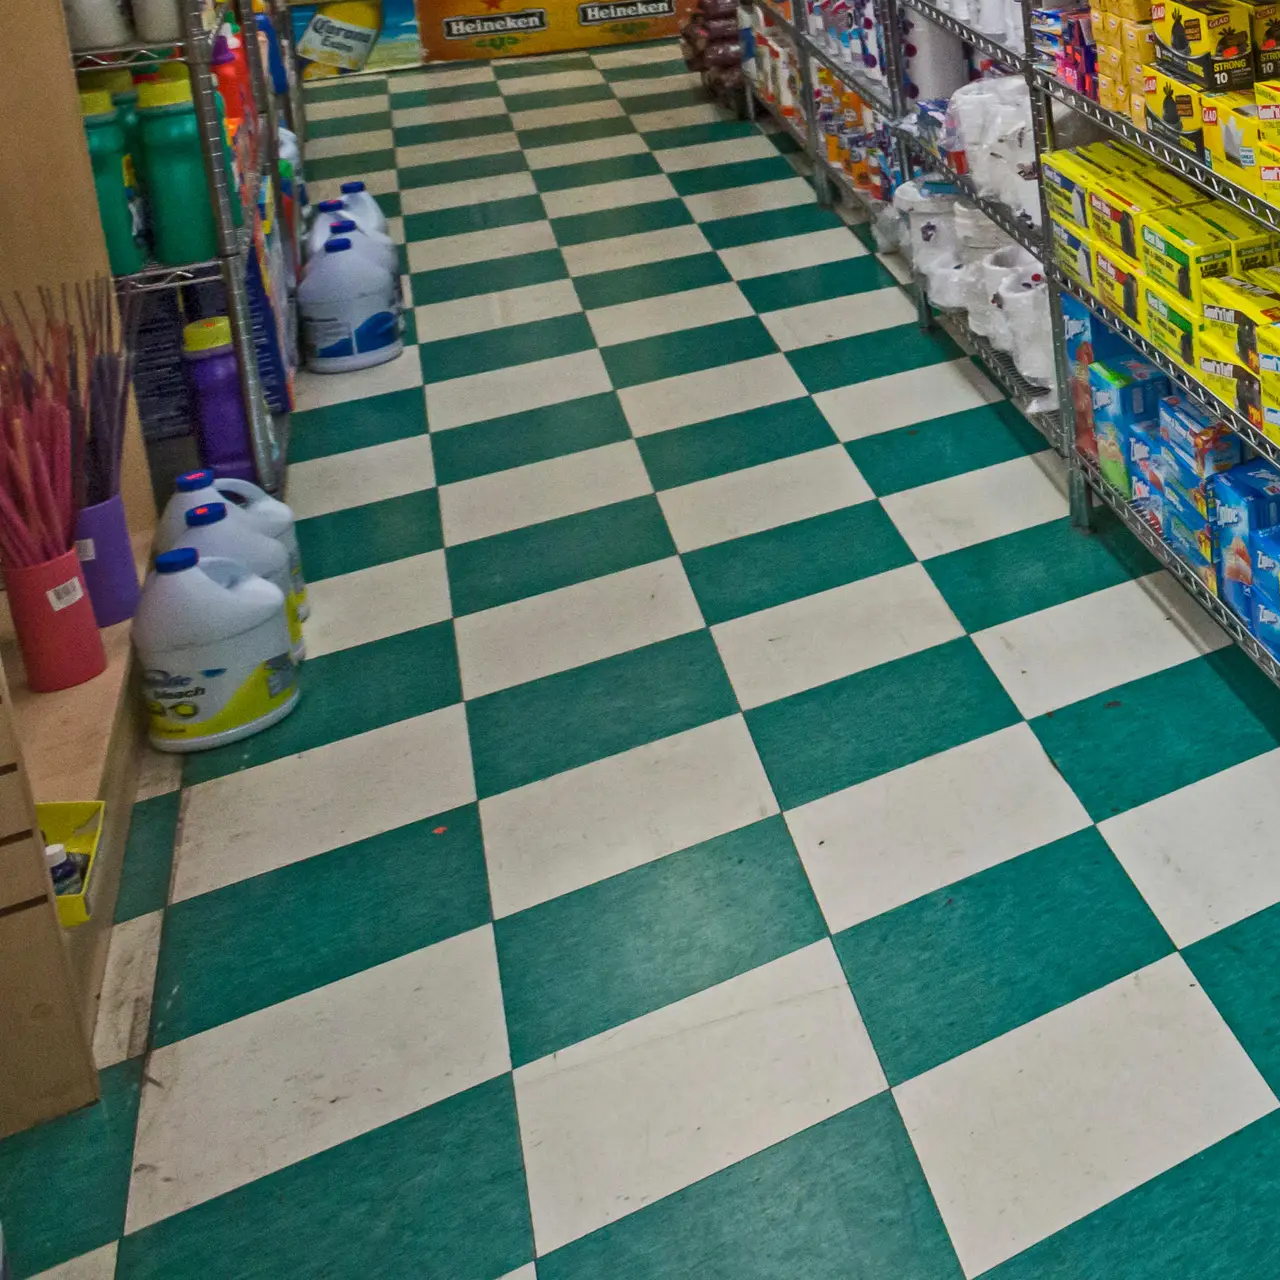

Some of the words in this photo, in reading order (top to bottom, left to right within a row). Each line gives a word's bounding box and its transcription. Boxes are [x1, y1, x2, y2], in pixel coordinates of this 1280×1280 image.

[586, 1, 671, 21] Heineken
[449, 15, 540, 36] Heineken
[1208, 16, 1230, 28] GLAD
[1213, 59, 1247, 72] STRONG
[1261, 62, 1274, 74] 10
[1214, 73, 1228, 86] 10
